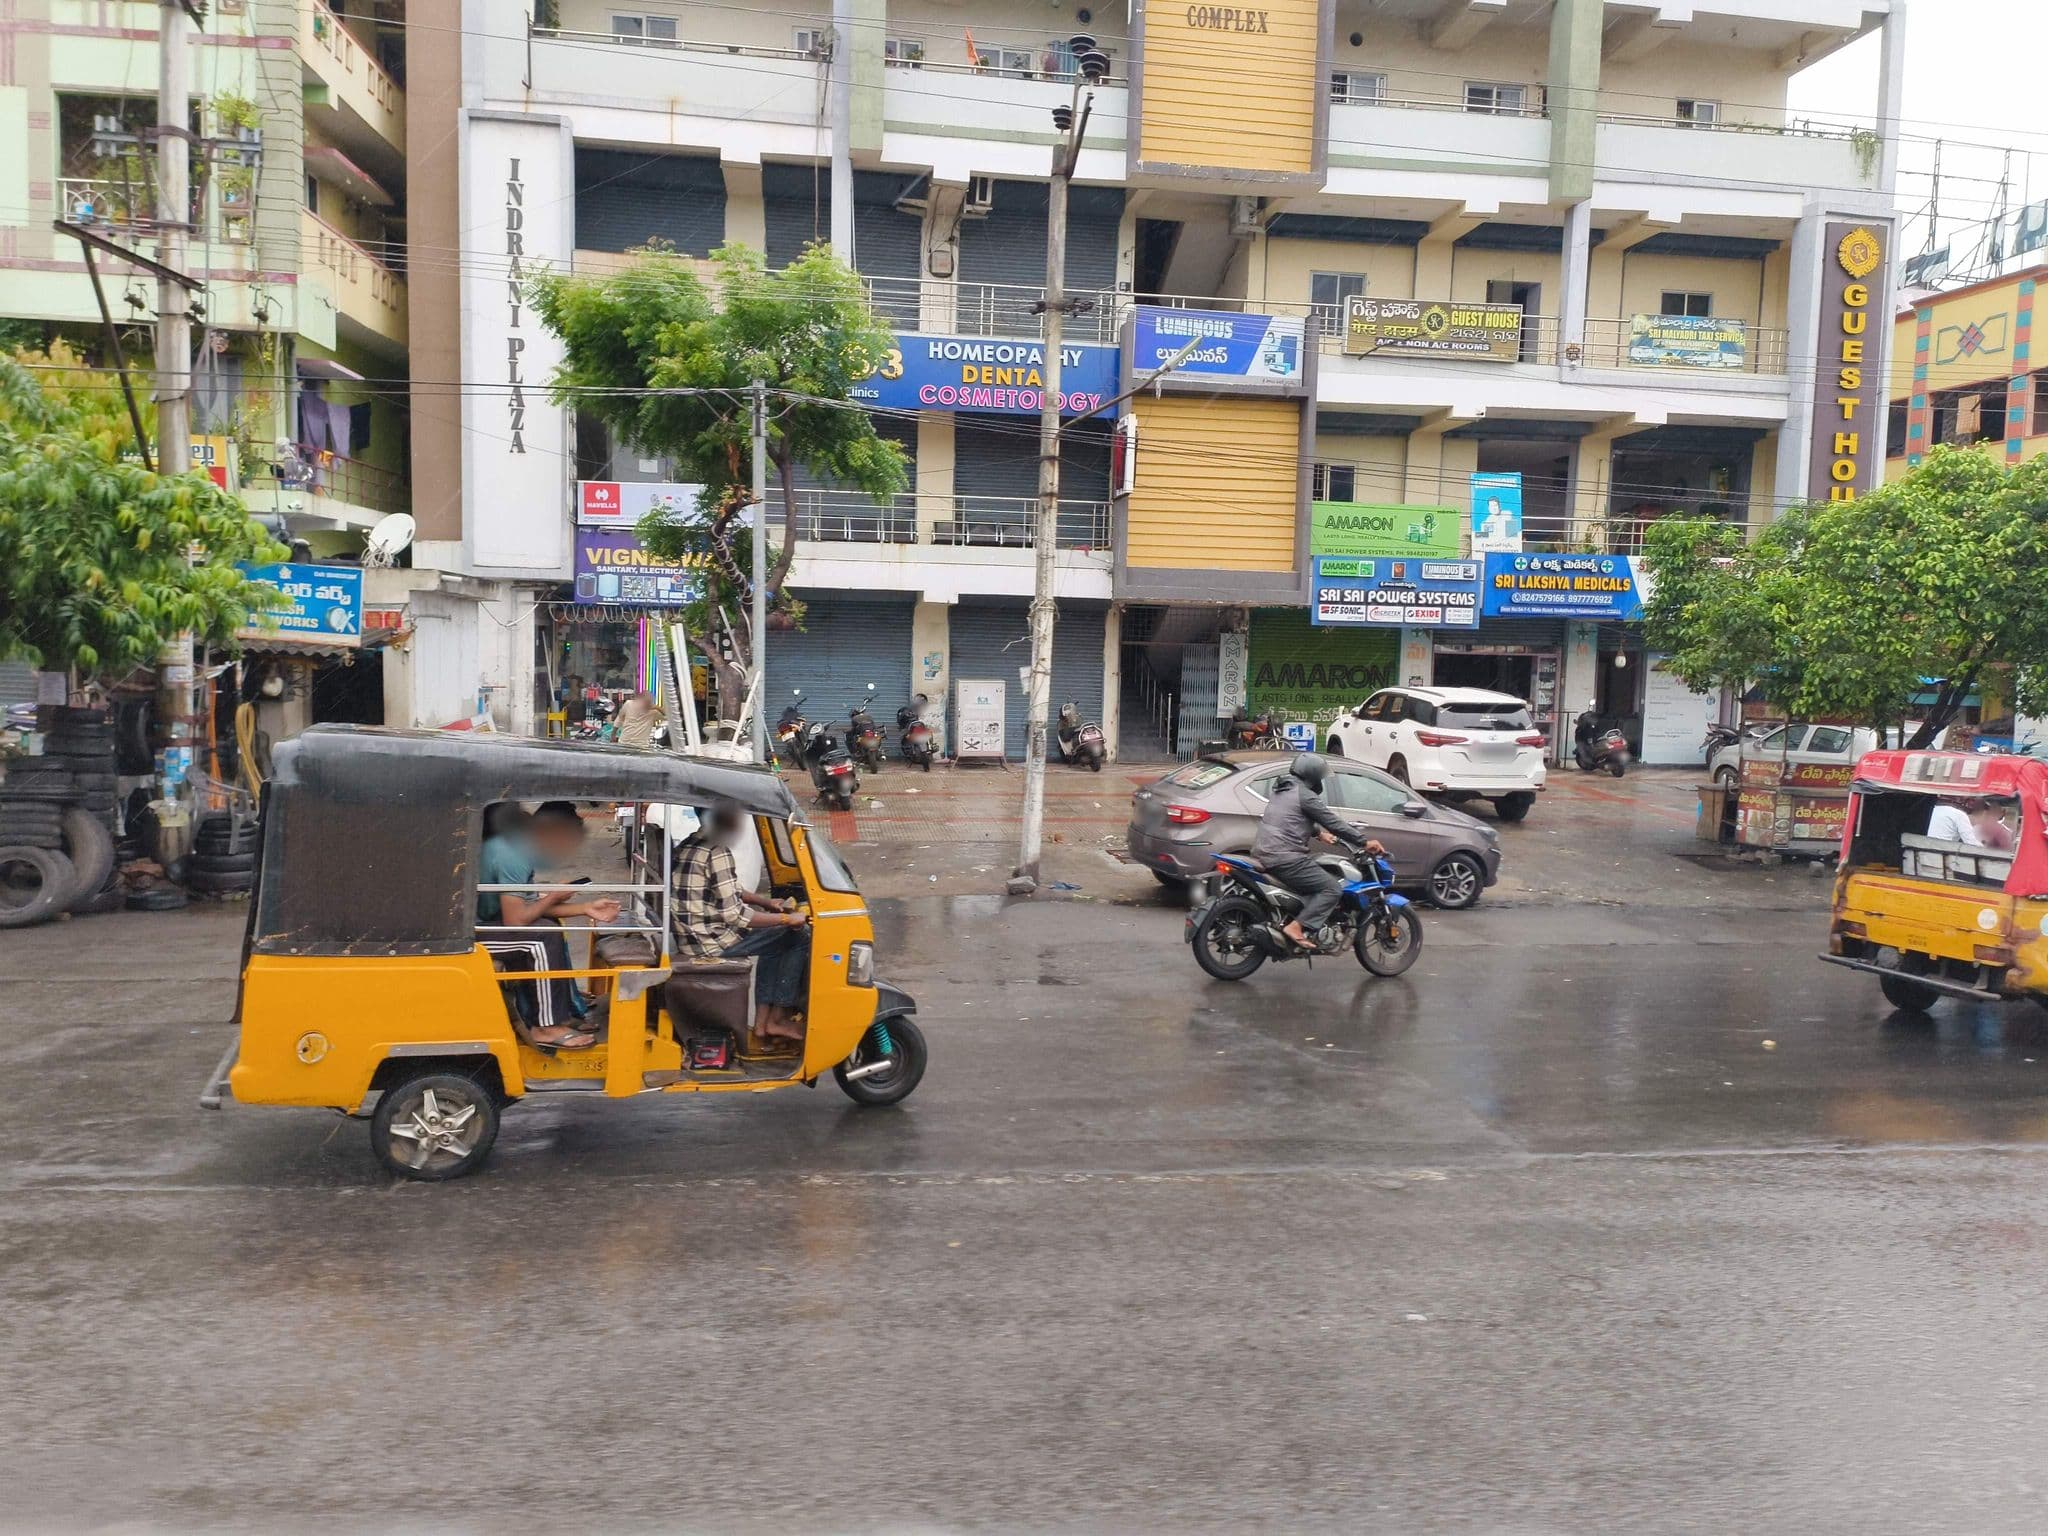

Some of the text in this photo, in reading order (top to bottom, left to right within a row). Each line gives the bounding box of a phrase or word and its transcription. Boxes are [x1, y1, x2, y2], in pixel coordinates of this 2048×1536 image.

[1187, 5, 1268, 33] COMPLEX
[506, 158, 526, 453] INDRANI PLAZA
[1155, 316, 1233, 338] LUMINOUS
[1451, 310, 1519, 329] GUEST HOUSE
[1406, 339, 1428, 348] NON
[1432, 341, 1449, 350] A/C
[1451, 343, 1490, 351] ROOMS
[1648, 328, 1661, 338] SRI
[1698, 331, 1714, 341] TAXI
[1714, 331, 1745, 345] SERVICE
[929, 341, 1083, 367] HOMEOPAHY
[962, 365, 1043, 387] DENTA
[1831, 284, 1868, 502] GUEST HOU
[1325, 515, 1394, 531] AMARON
[596, 566, 639, 574] SANITARY,
[1322, 562, 1357, 571] AMARON
[1425, 565, 1459, 576] LUMINOUS
[1495, 574, 1631, 591] SRI LAKSHYA MEDICALS
[1319, 589, 1476, 606] SRI SAI POWER SYSTEMS
[1224, 635, 1240, 707] AMARON
[1254, 662, 1394, 689] AMARON
